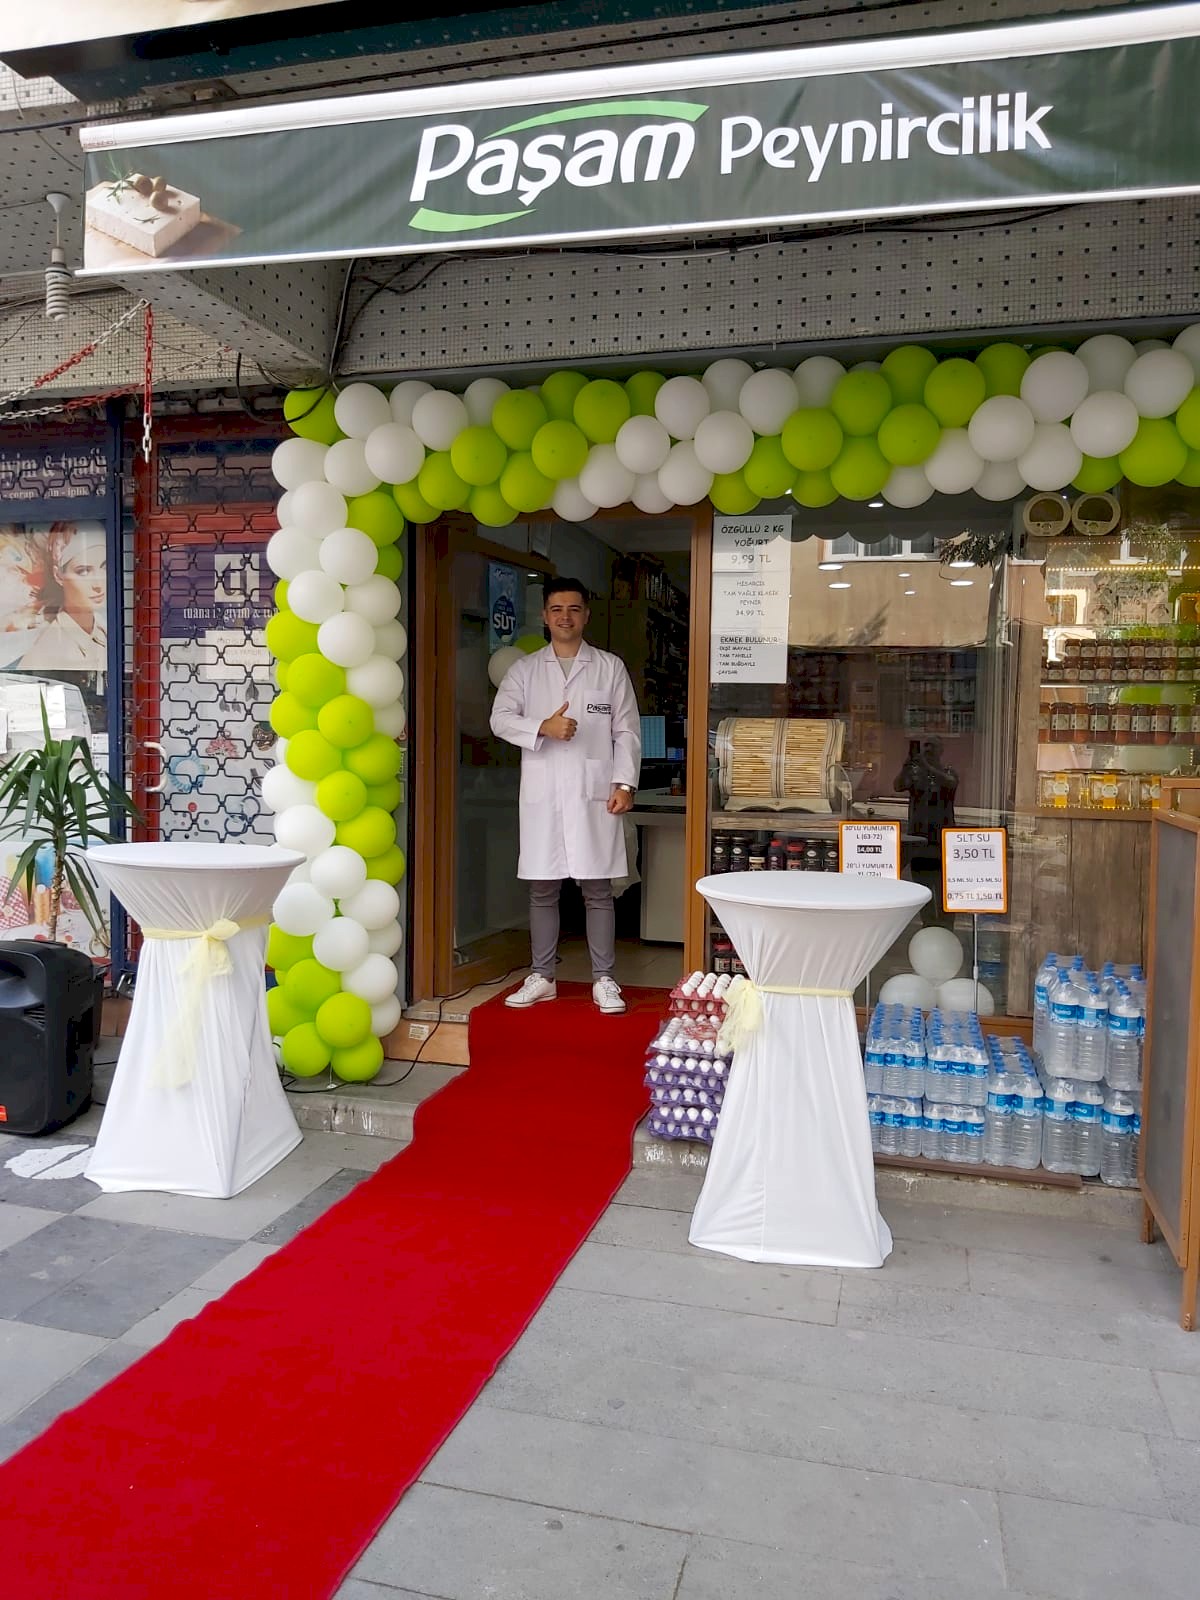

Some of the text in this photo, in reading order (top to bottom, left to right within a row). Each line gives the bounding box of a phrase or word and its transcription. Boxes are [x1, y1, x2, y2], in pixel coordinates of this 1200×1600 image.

[409, 91, 1055, 207] Paşam Peynircilik
[721, 523, 785, 534] ÖZGÜLLÜ 2 KG
[735, 537, 770, 547] YOĞURT
[759, 554, 772, 563] TL
[183, 606, 210, 620] tuana
[493, 611, 516, 631] SÜT
[977, 833, 990, 843] SU
[953, 848, 996, 860] 3,50 TL
[995, 892, 1004, 900] TL
